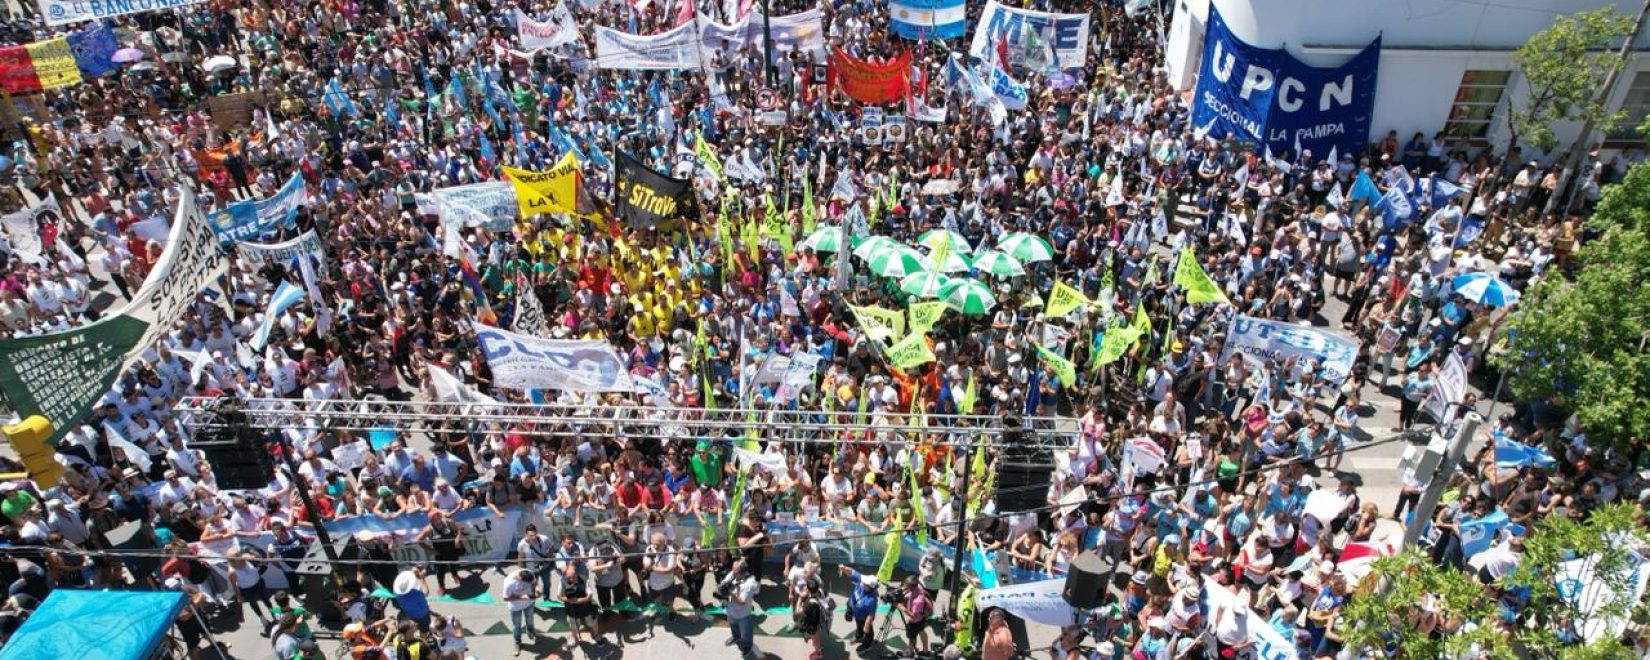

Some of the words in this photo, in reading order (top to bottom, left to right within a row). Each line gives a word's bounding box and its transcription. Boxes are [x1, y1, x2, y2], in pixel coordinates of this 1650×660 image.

[72, 1, 89, 14] EL
[91, 0, 151, 17] BANCO
[1212, 40, 1353, 112] UPCN
[1203, 90, 1263, 139] SECCIONAL
[1270, 128, 1287, 141] LA
[1297, 121, 1345, 140] PAMPA
[528, 196, 547, 207] LA
[218, 220, 259, 242] ATRE
[7, 339, 68, 364] SINDATO
[1226, 341, 1276, 360] SECCIONA
